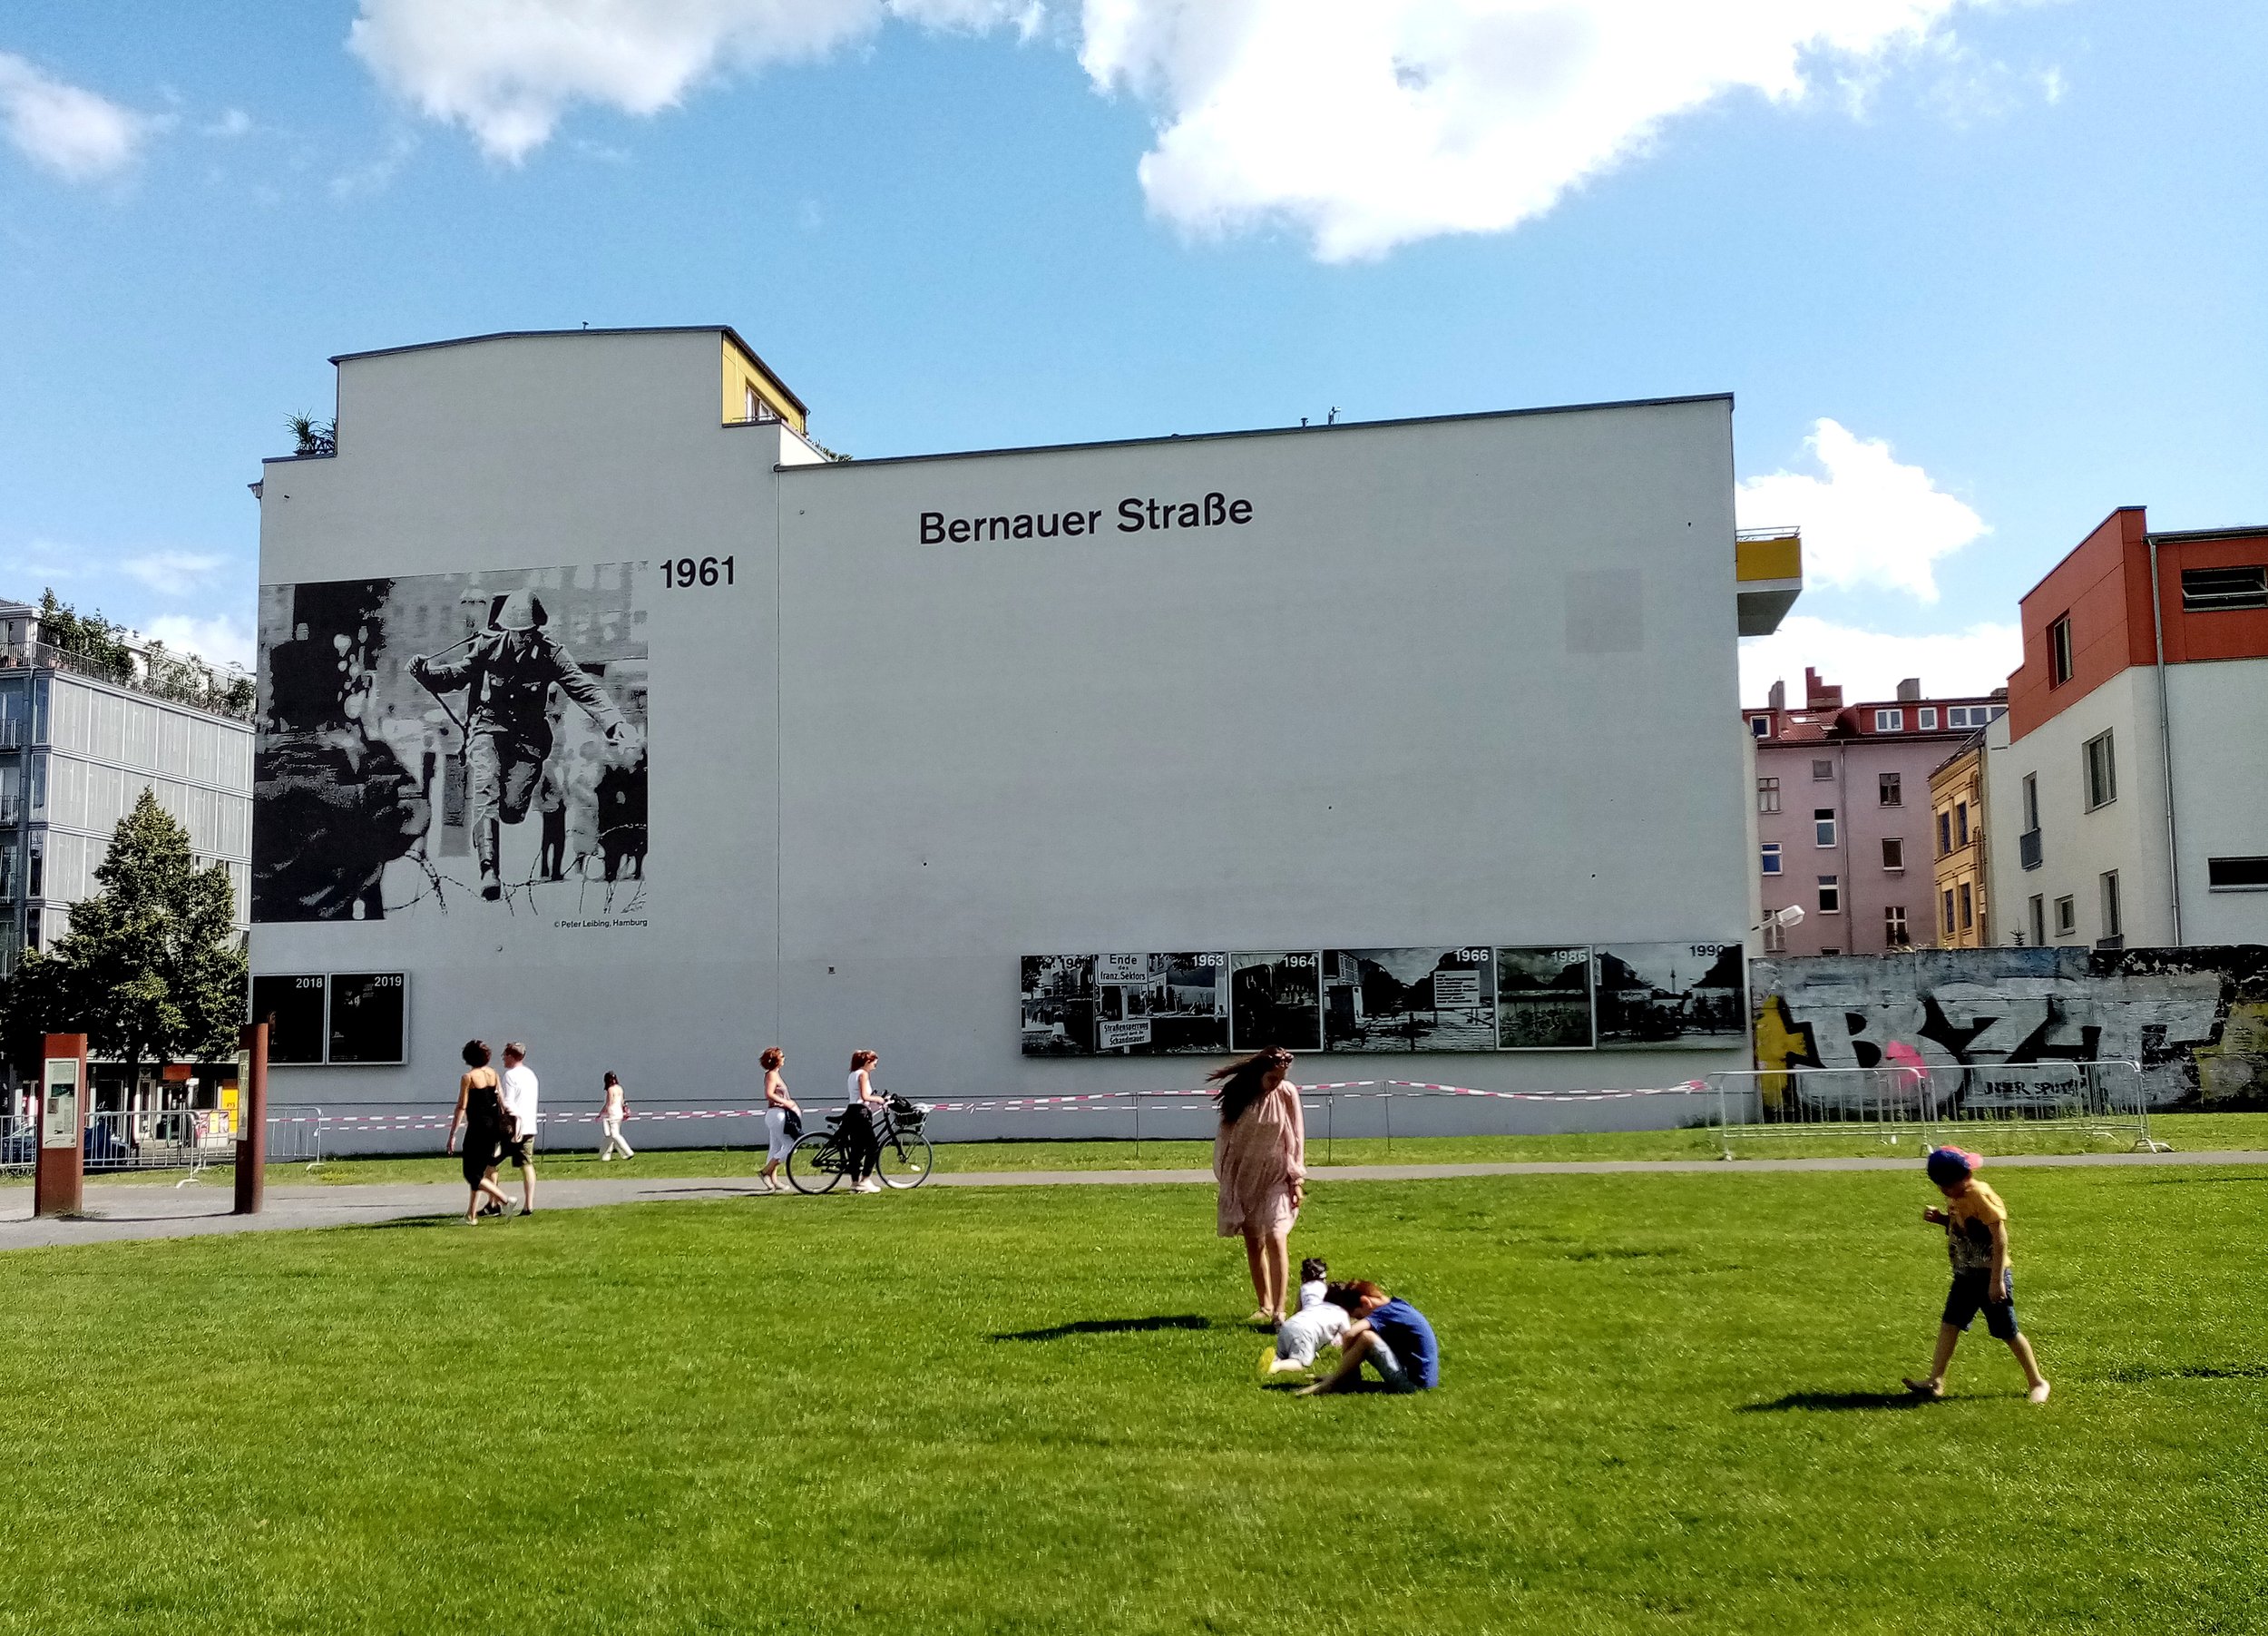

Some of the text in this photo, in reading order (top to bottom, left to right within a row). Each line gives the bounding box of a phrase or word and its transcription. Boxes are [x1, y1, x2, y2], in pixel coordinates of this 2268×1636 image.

[921, 493, 1254, 544] Bernauer Straße
[660, 556, 735, 589] 1961
[562, 920, 582, 928] Peter
[582, 919, 611, 928] Leibing,
[612, 918, 648, 927] Hamburg
[1110, 954, 1138, 965] Ende
[1192, 955, 1225, 967] 1963
[1283, 955, 1316, 968] 1964
[1453, 949, 1489, 962] 1966
[1550, 950, 1588, 963] 1986
[1060, 957, 1090, 970] 196
[296, 977, 323, 988] 2018
[374, 975, 402, 987] 2019
